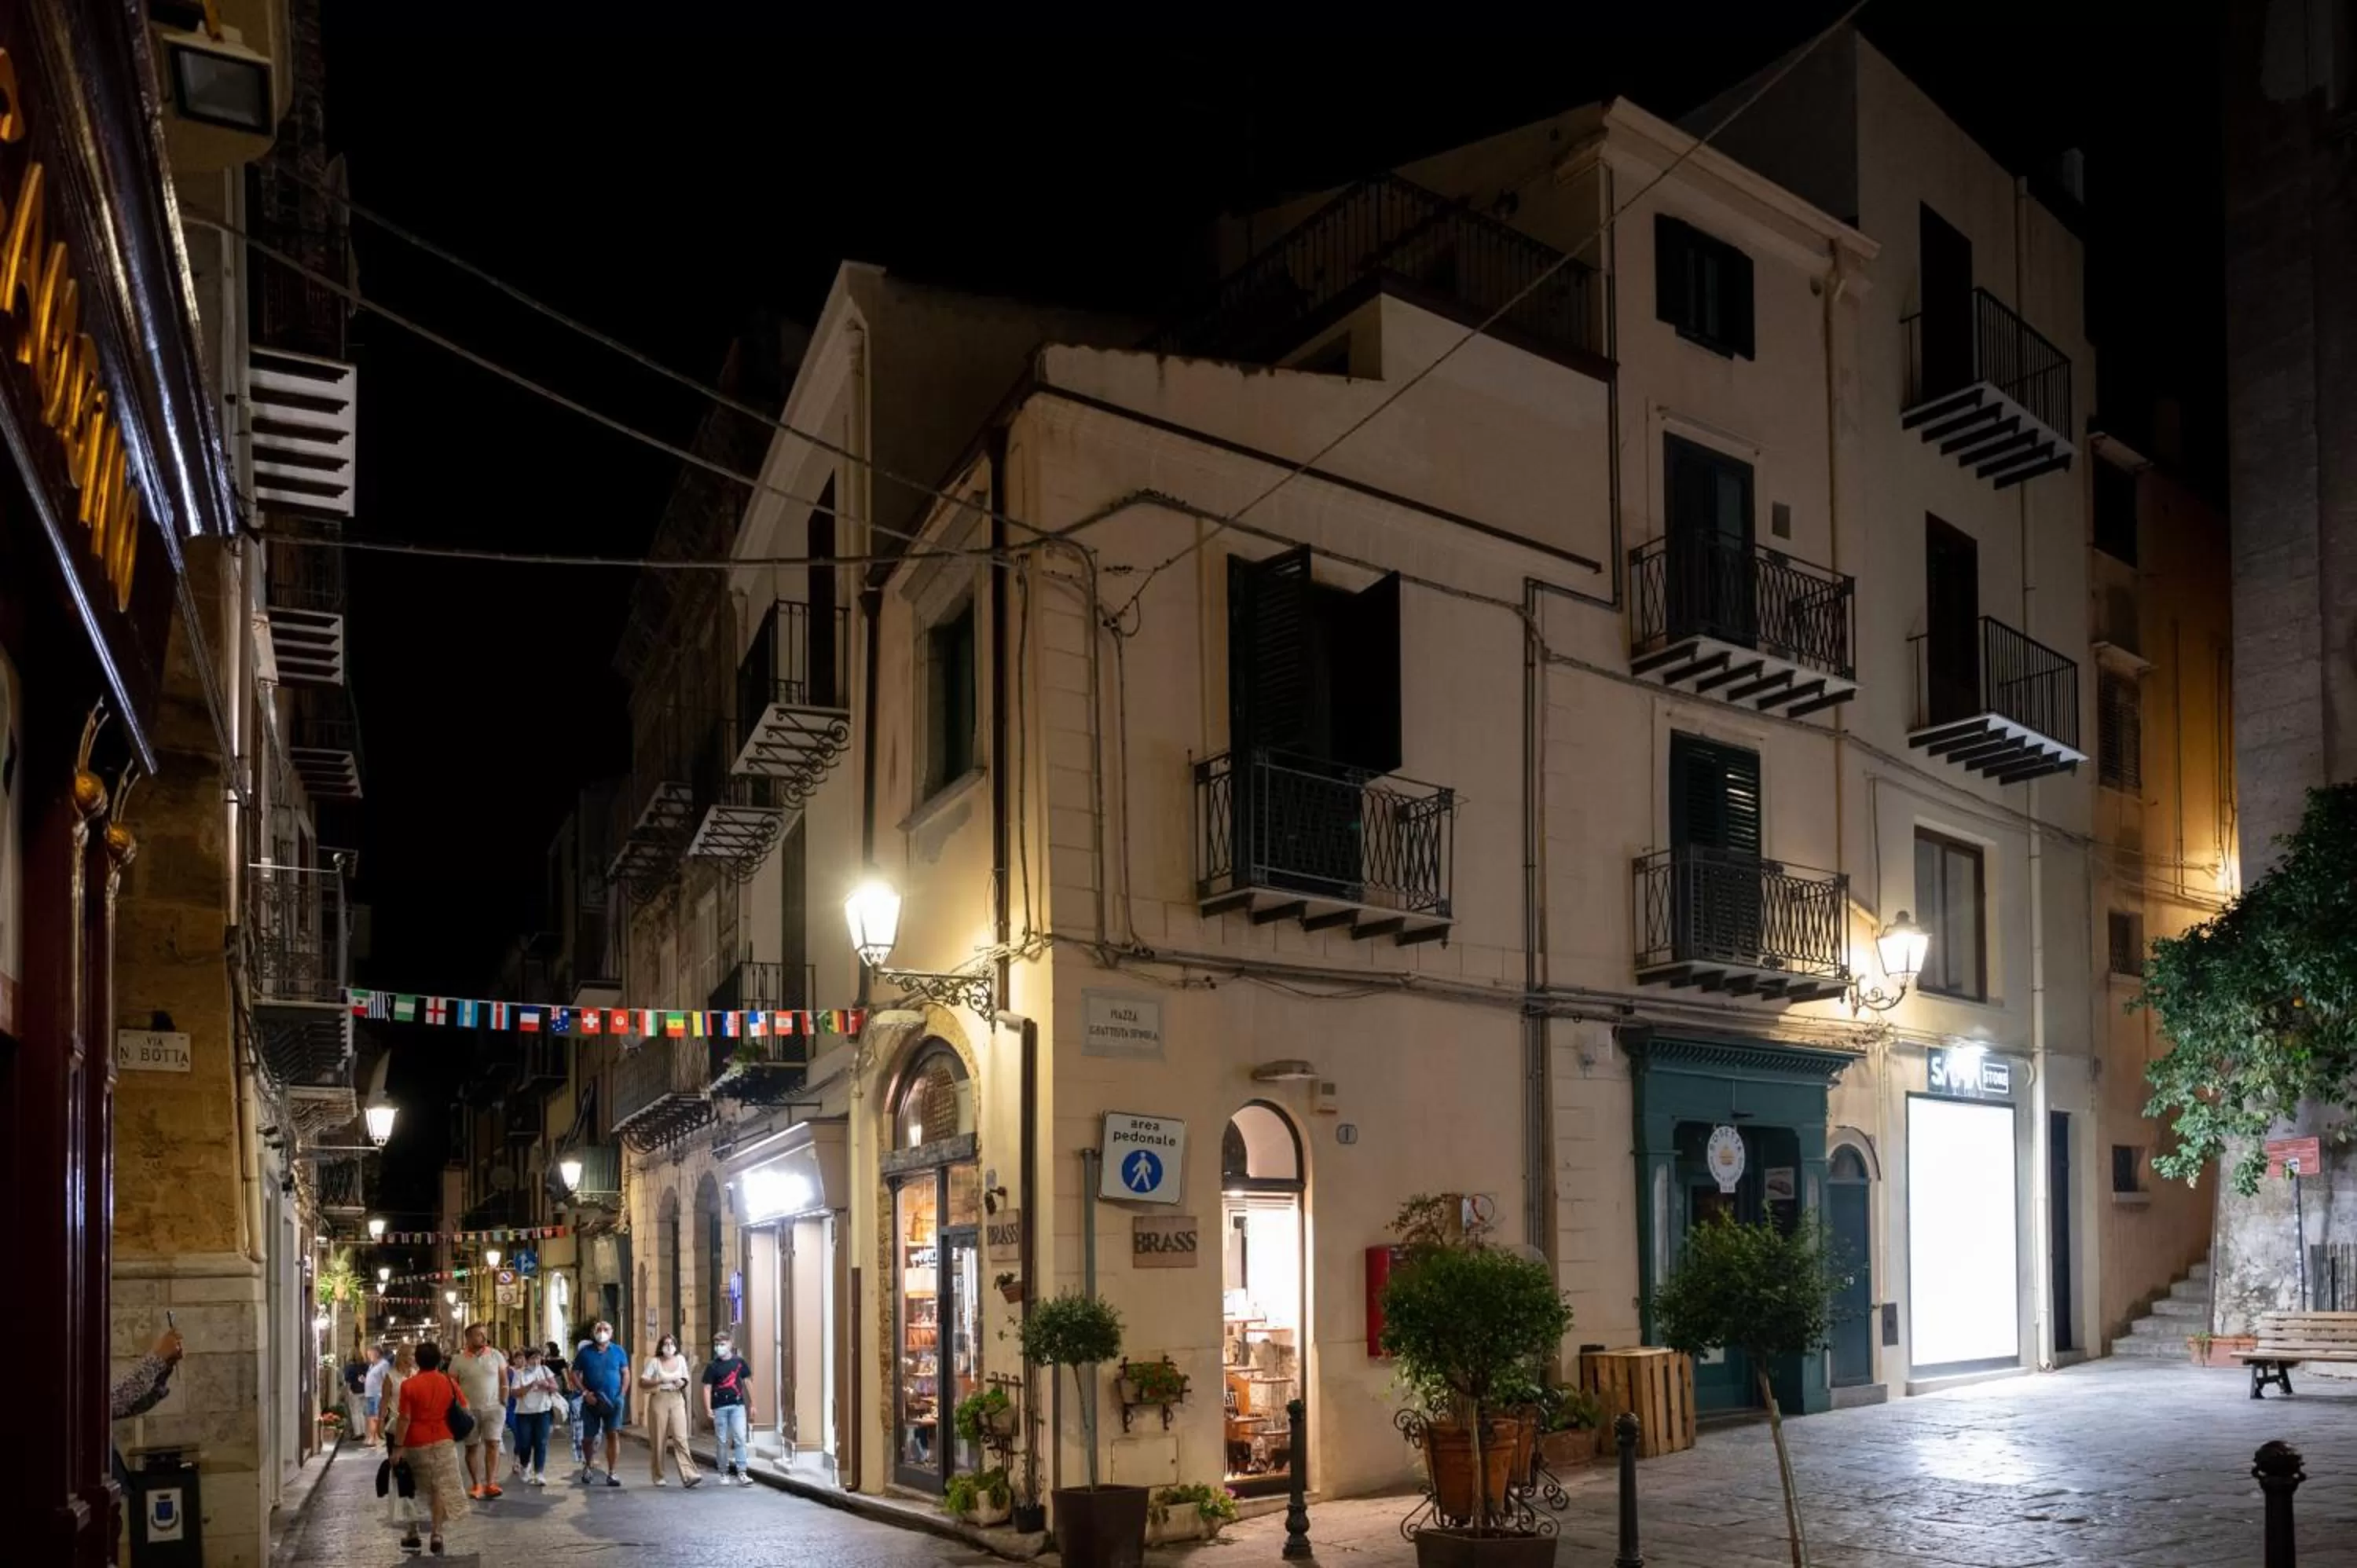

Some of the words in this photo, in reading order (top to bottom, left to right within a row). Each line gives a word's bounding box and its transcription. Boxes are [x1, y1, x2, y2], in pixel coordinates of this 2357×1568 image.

[146, 1037, 163, 1046] VIA
[141, 1048, 189, 1064] BOTTA
[1131, 1119, 1160, 1131] area
[1113, 1130, 1176, 1147] pedonale
[1134, 1231, 1197, 1254] BRASS
